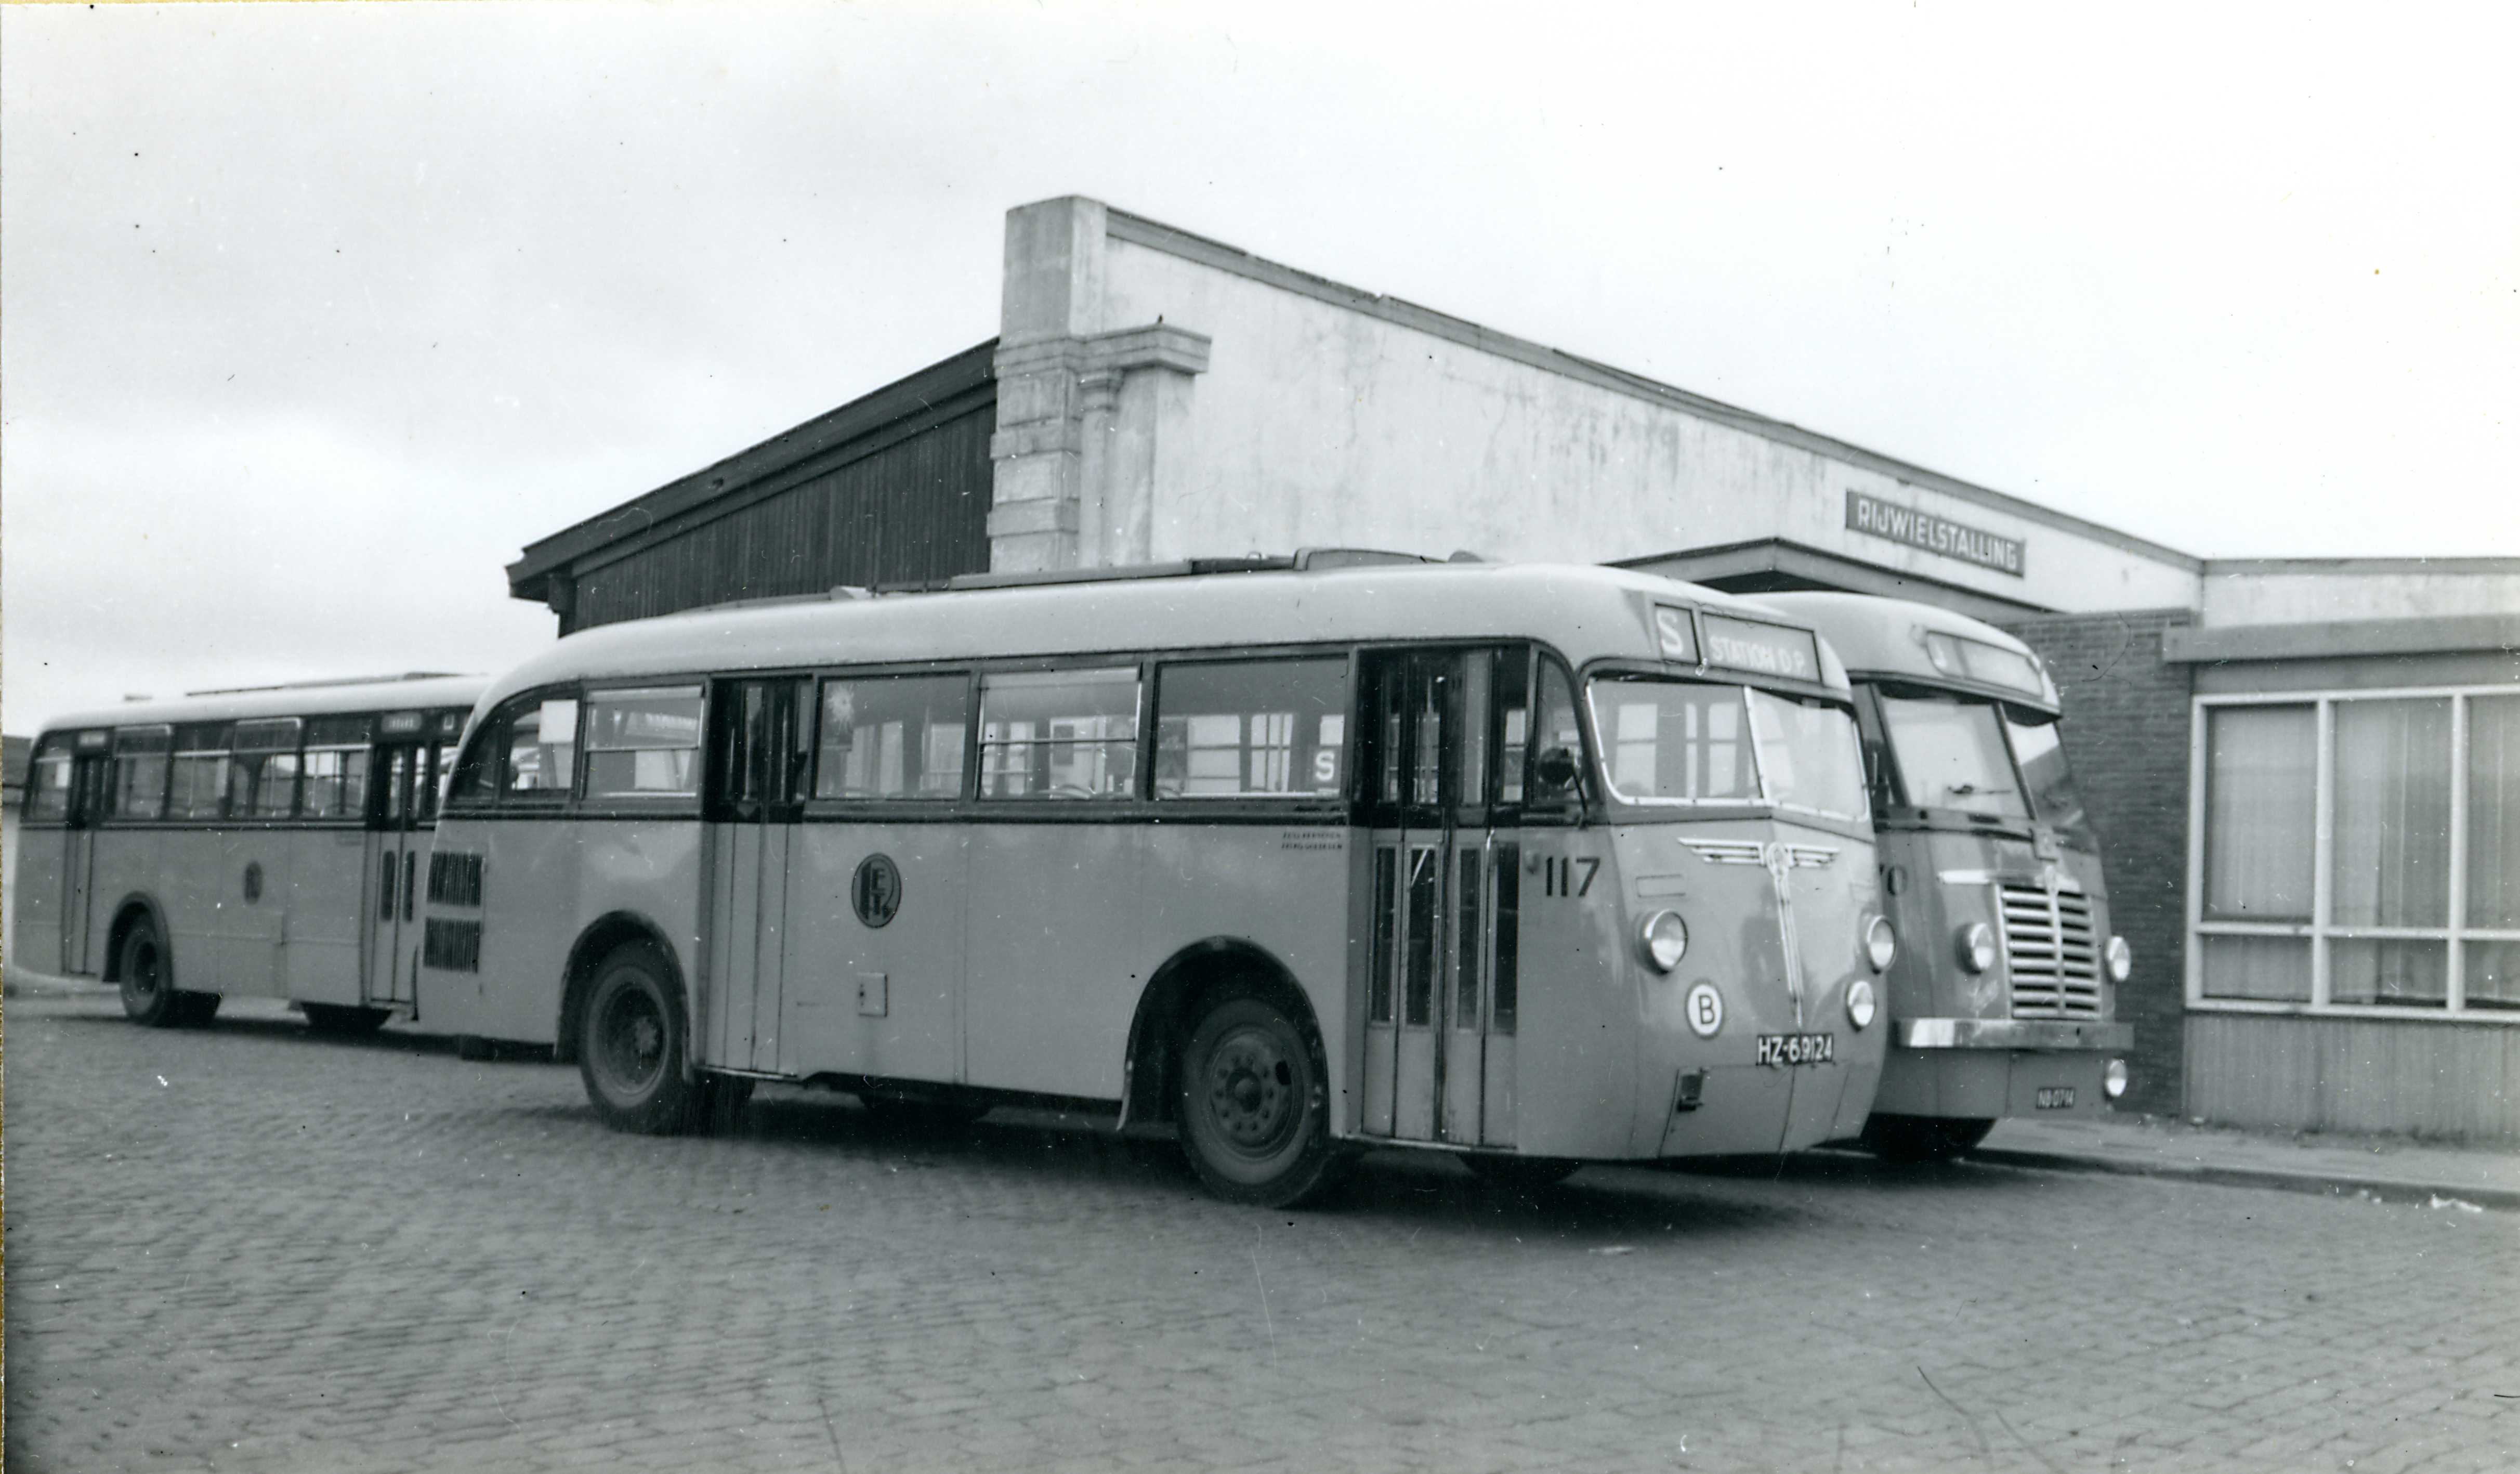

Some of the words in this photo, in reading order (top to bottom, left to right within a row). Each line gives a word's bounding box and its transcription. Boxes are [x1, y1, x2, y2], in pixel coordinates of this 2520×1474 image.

[1858, 500, 2017, 570] RIJWIELSTALLING
[1657, 609, 1682, 654] S
[1710, 636, 1776, 671] STATION
[1315, 750, 1335, 780] S
[1546, 857, 1600, 896] 117
[1699, 995, 1715, 1024] B
[1758, 1037, 1832, 1063] HZ-69124
